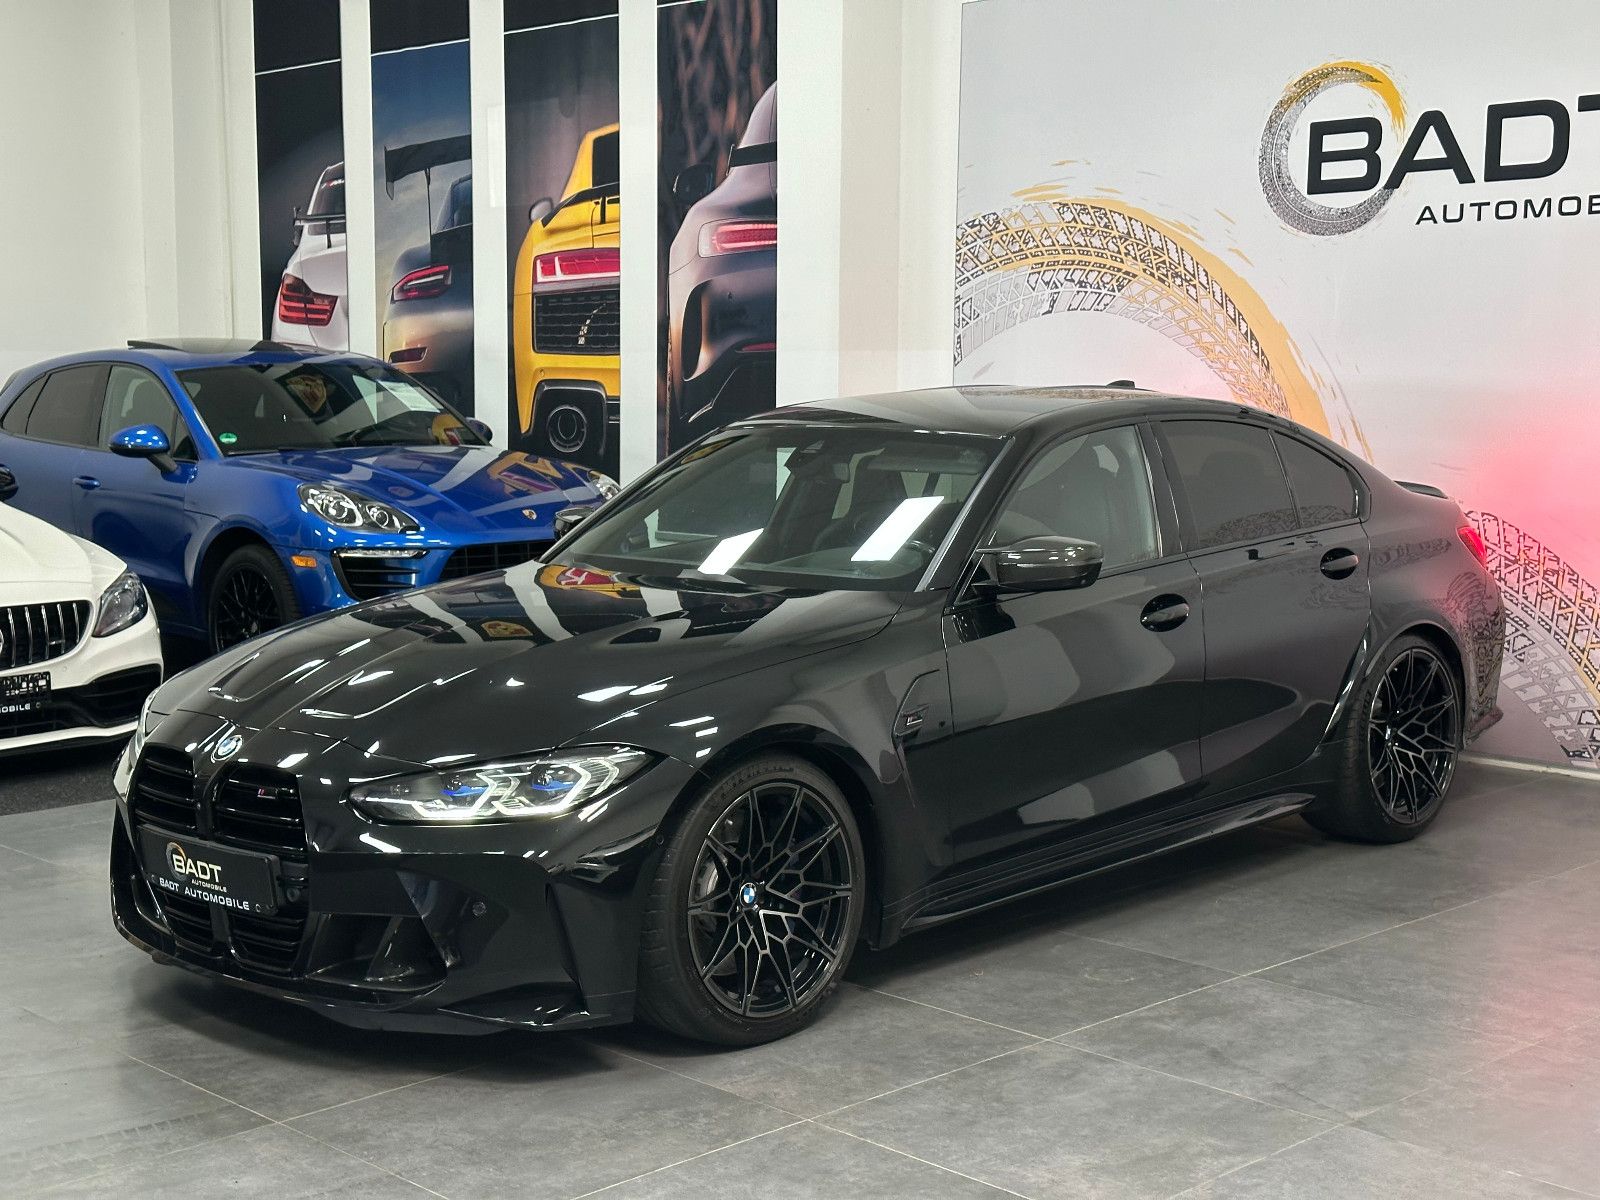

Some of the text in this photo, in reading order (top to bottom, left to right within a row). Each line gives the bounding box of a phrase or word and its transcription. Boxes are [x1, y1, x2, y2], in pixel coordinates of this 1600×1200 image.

[0, 703, 31, 713] OBILE
[172, 854, 222, 883] BADT
[159, 877, 250, 911] BADT AUTOMOBILE
[191, 879, 227, 893] AUTOMOBILE
